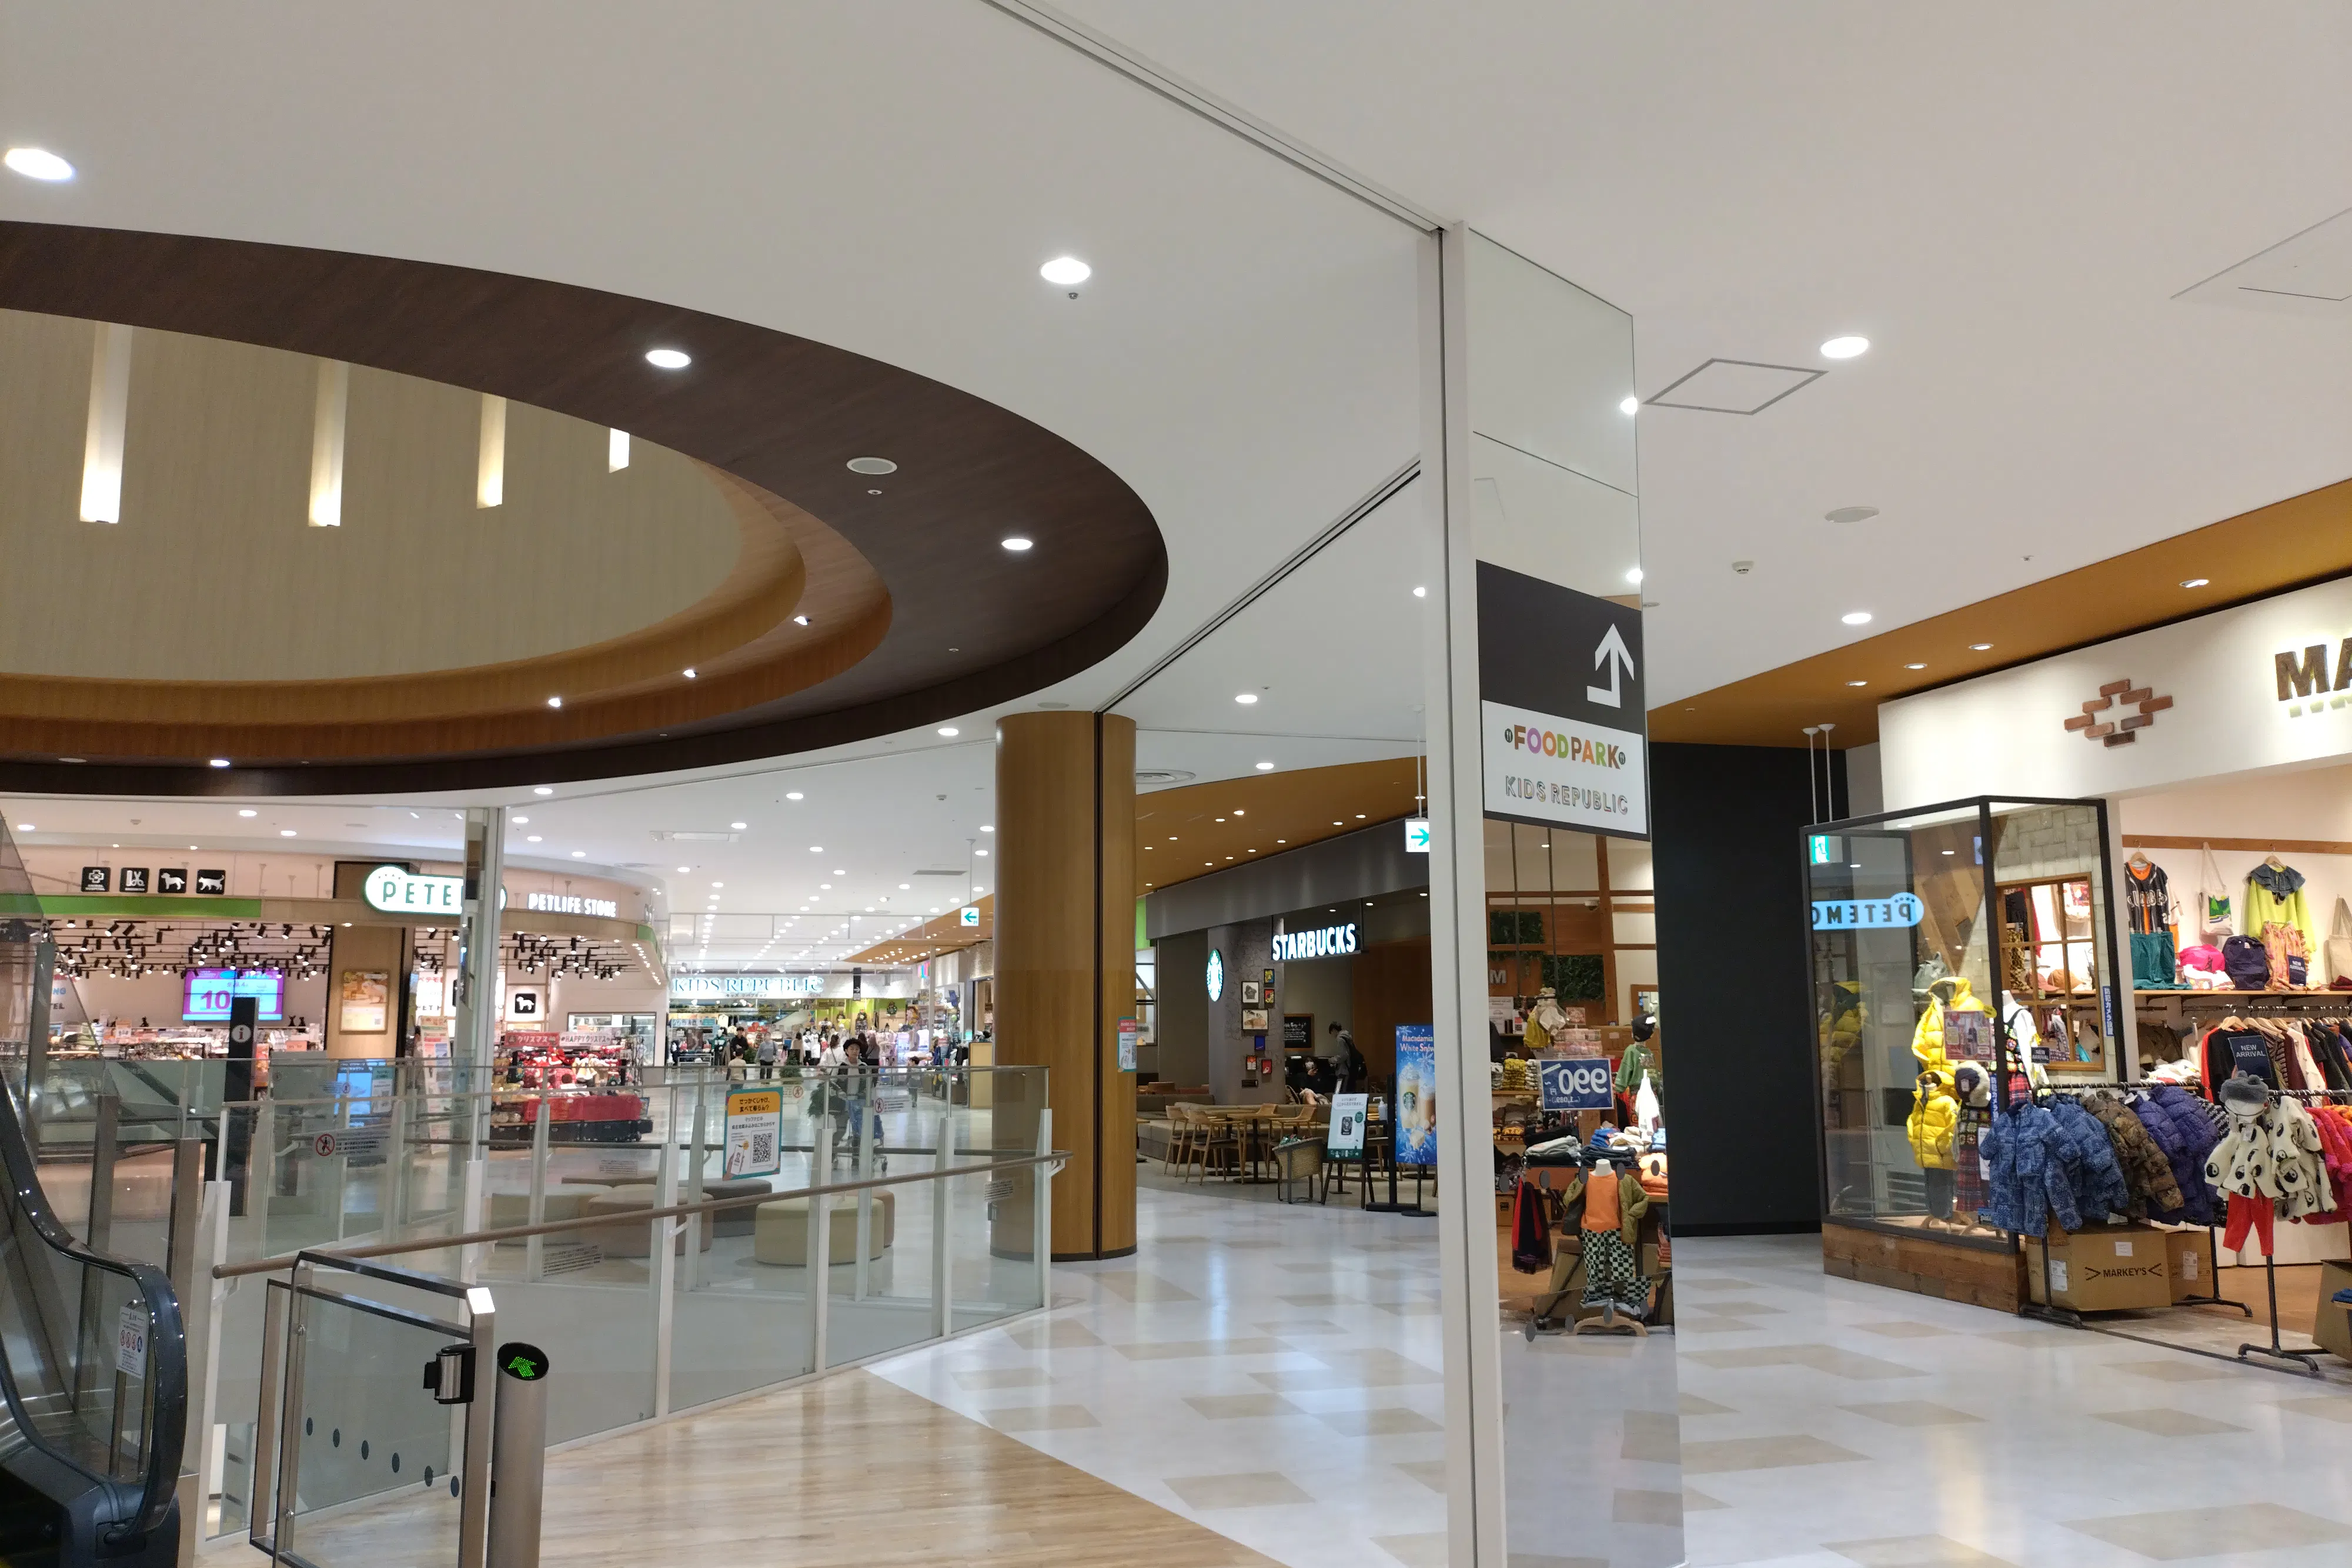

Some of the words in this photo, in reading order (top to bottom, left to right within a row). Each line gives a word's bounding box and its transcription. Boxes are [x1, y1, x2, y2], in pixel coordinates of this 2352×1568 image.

[1505, 775, 1546, 803] KIDS
[1551, 783, 1628, 815] REPUBLIC
[383, 881, 463, 907] PETE
[527, 893, 581, 914] PETLIFE
[584, 898, 617, 918] STORE
[1272, 924, 1356, 961] STARBUCKS
[674, 978, 720, 991] KIDS
[726, 978, 823, 991] REPUBLIC
[1400, 1043, 1418, 1052] White
[1419, 1043, 1435, 1052] Snow
[2103, 1267, 2146, 1278] MARKEY'S
